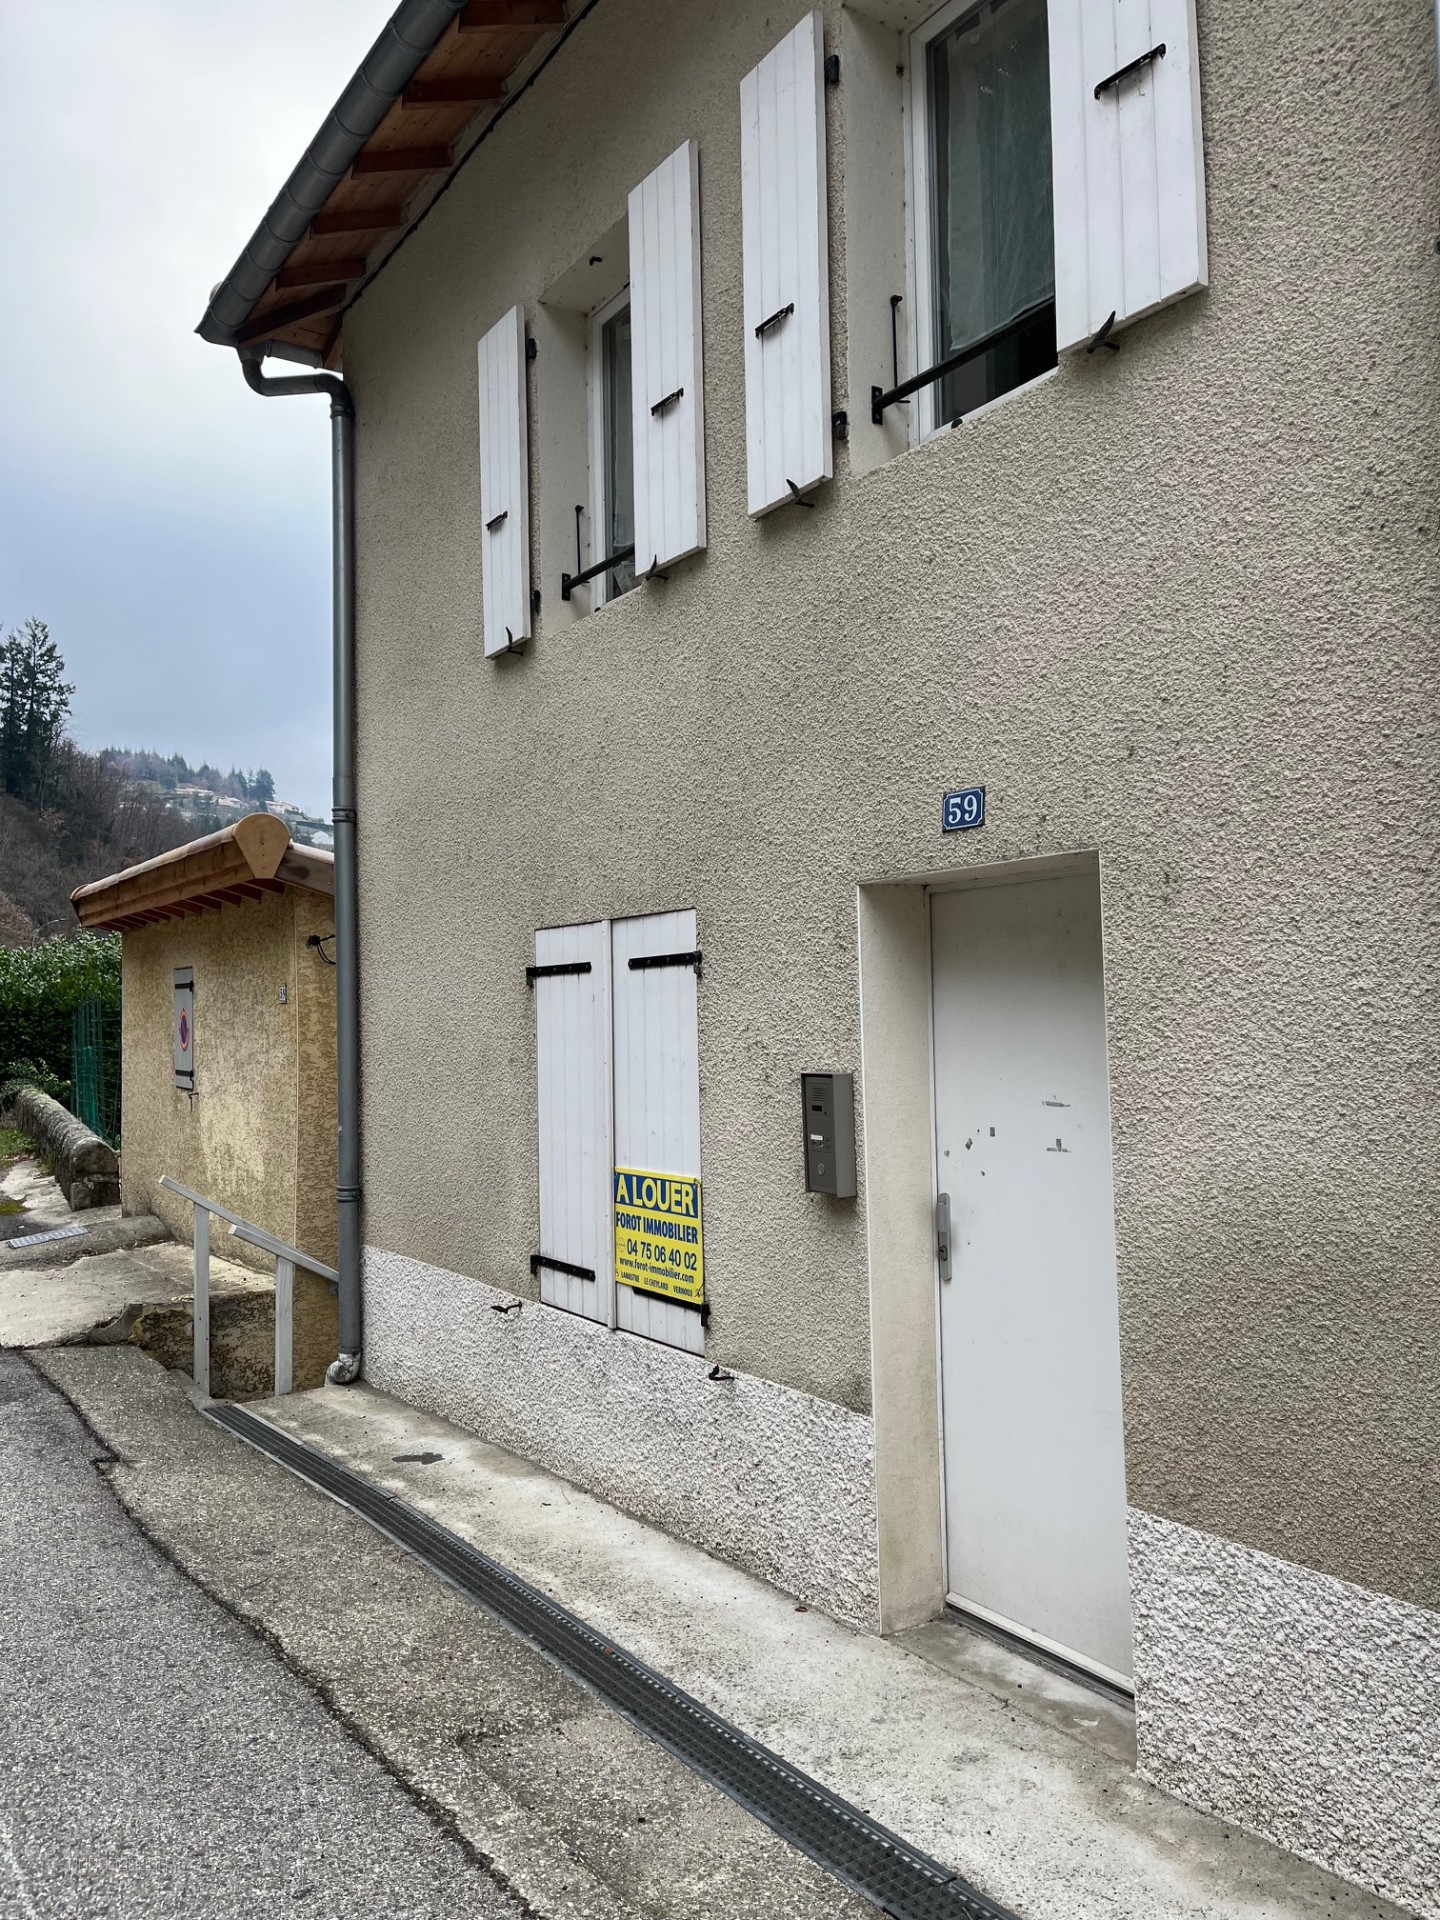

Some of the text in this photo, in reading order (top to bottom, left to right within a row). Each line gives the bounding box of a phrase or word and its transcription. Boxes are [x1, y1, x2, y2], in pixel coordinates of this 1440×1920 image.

[948, 795, 977, 824] 59
[616, 1174, 695, 1216] A LOUER
[616, 1212, 699, 1245] FOROT IMMOBILIER
[619, 1257, 694, 1284] www.forot-immobilier.com
[626, 1238, 697, 1271] 04 75 06 40 02
